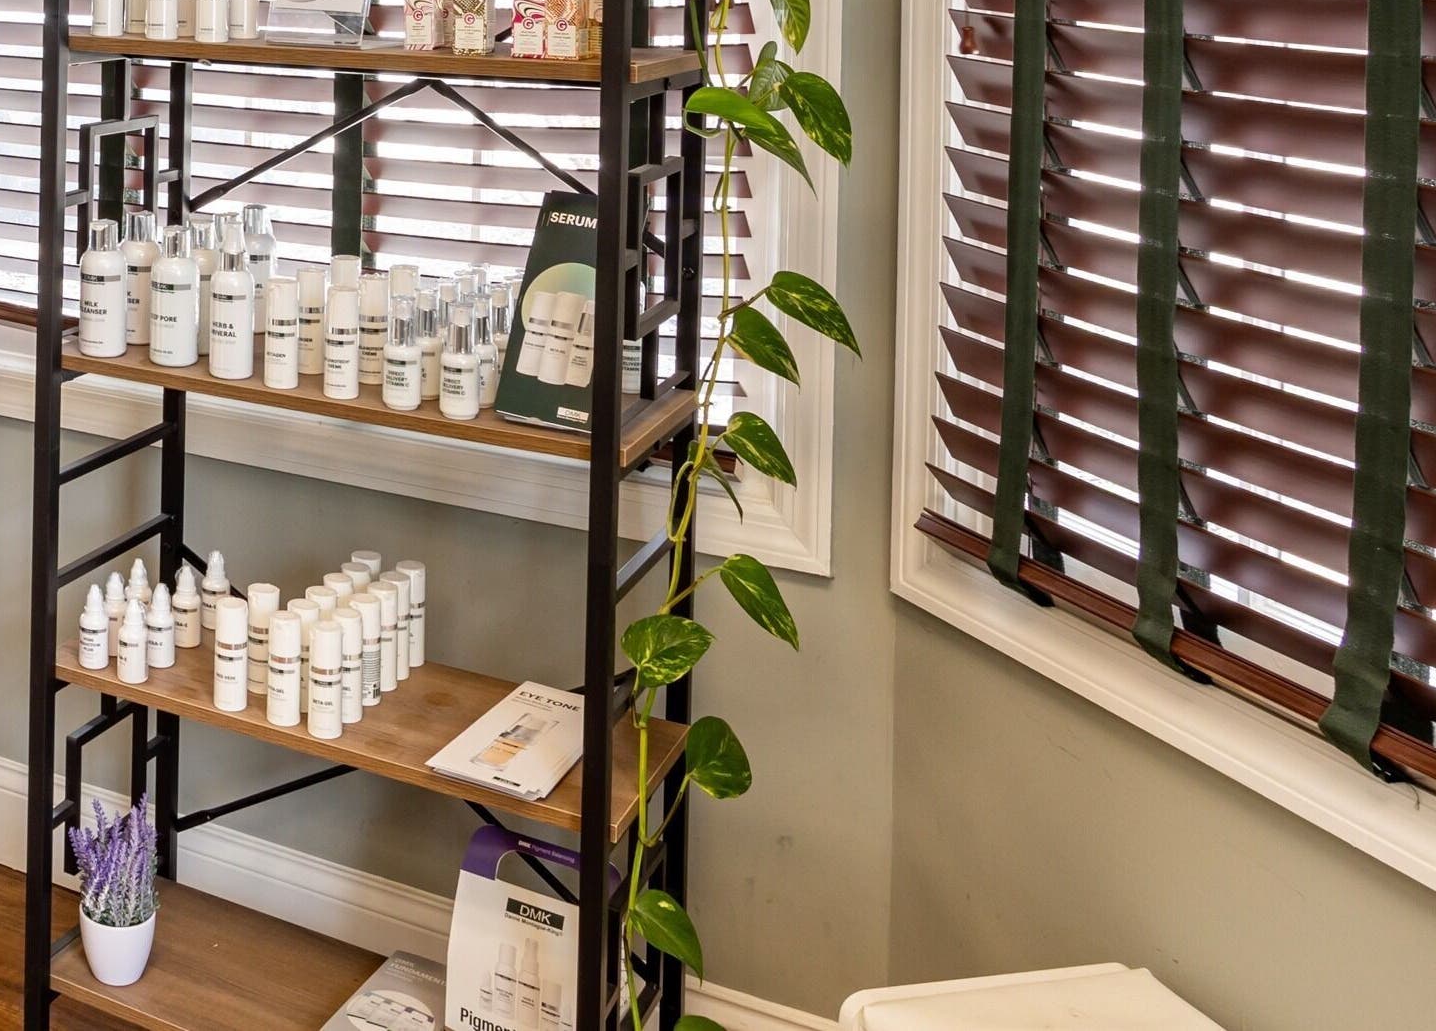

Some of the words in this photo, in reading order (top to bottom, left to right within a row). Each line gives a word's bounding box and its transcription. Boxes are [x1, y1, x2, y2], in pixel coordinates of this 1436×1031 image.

[519, 690, 543, 701] EYE
[545, 697, 581, 712] TONE
[518, 839, 532, 849] DMK
[519, 904, 552, 925] DMK
